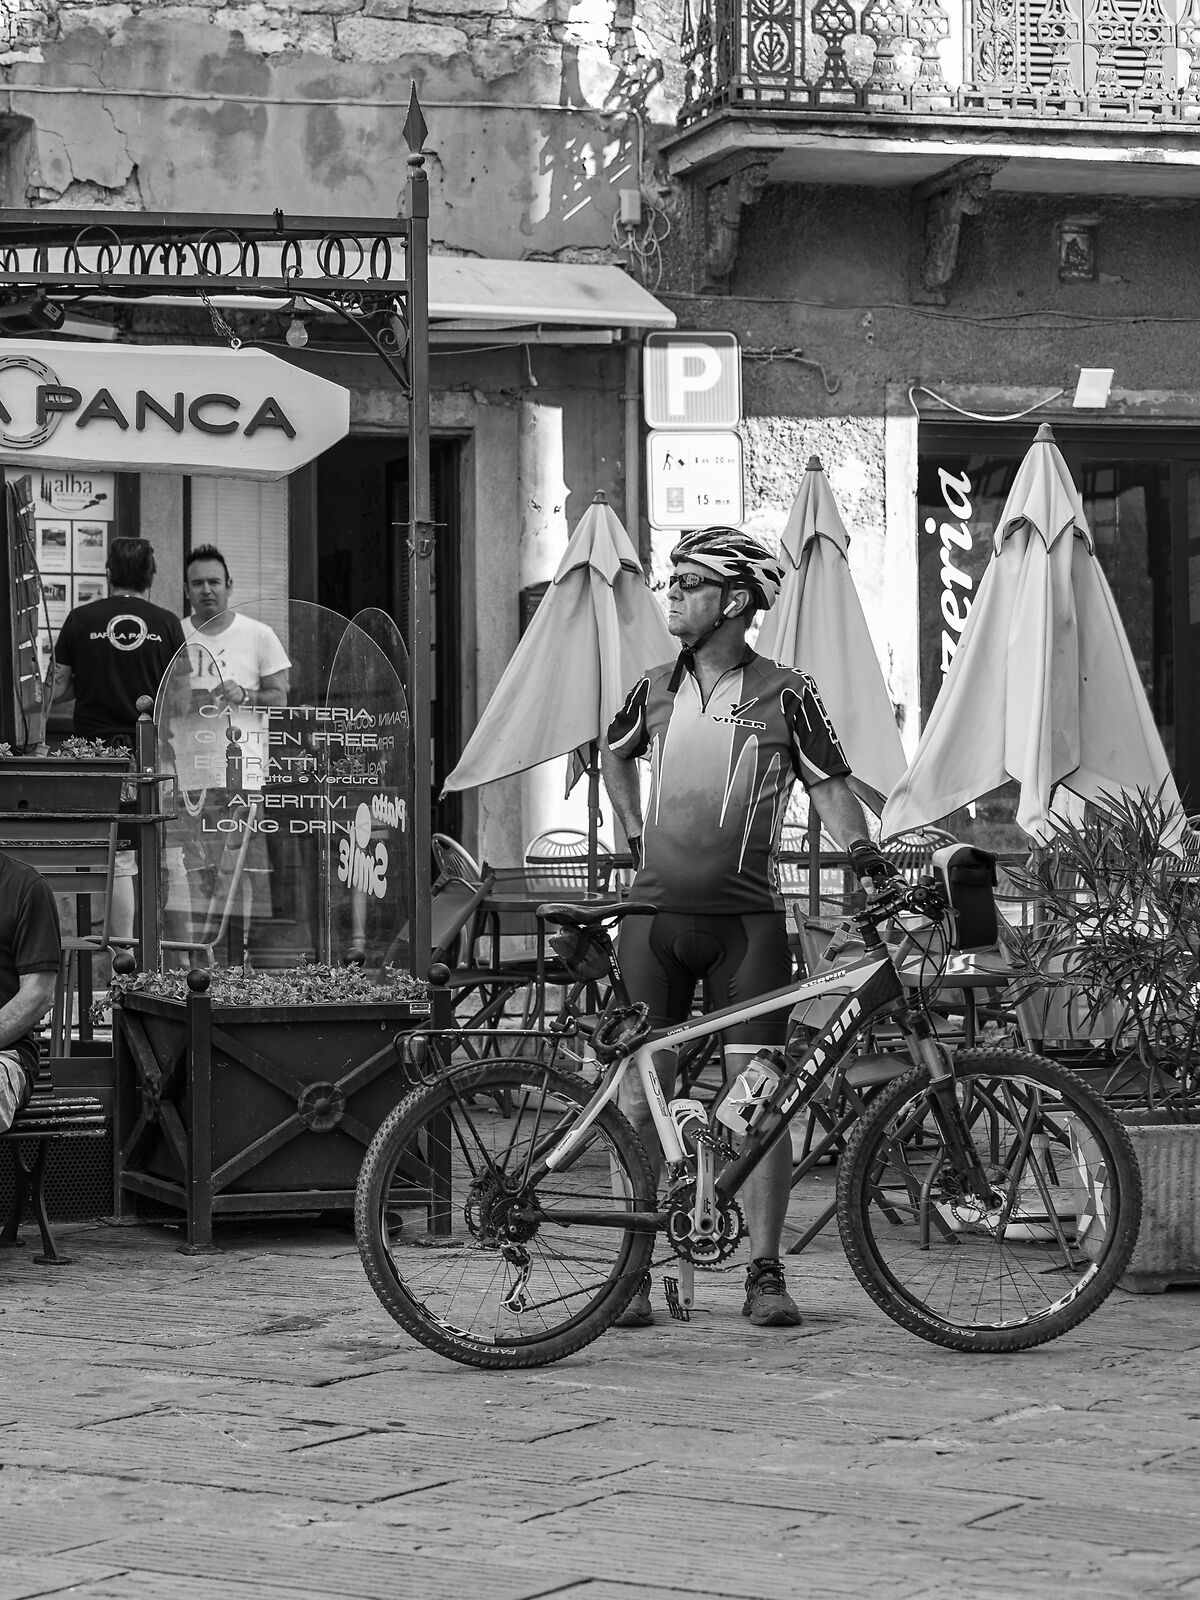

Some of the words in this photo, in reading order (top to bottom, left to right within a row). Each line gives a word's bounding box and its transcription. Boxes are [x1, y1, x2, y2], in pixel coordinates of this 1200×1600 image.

[667, 342, 722, 415] P
[35, 384, 297, 438] PANCA
[54, 472, 93, 493] alba
[697, 494, 709, 505] 15
[199, 704, 373, 722] CAFFETTERIA
[711, 714, 767, 730] VINER
[312, 732, 379, 747] FREE
[194, 755, 318, 772] ESTRATTI
[246, 773, 293, 784] Frutta
[298, 774, 309, 783] e
[315, 773, 379, 785] Verdura
[227, 793, 347, 809] APERITIVI
[202, 818, 280, 833] LONG
